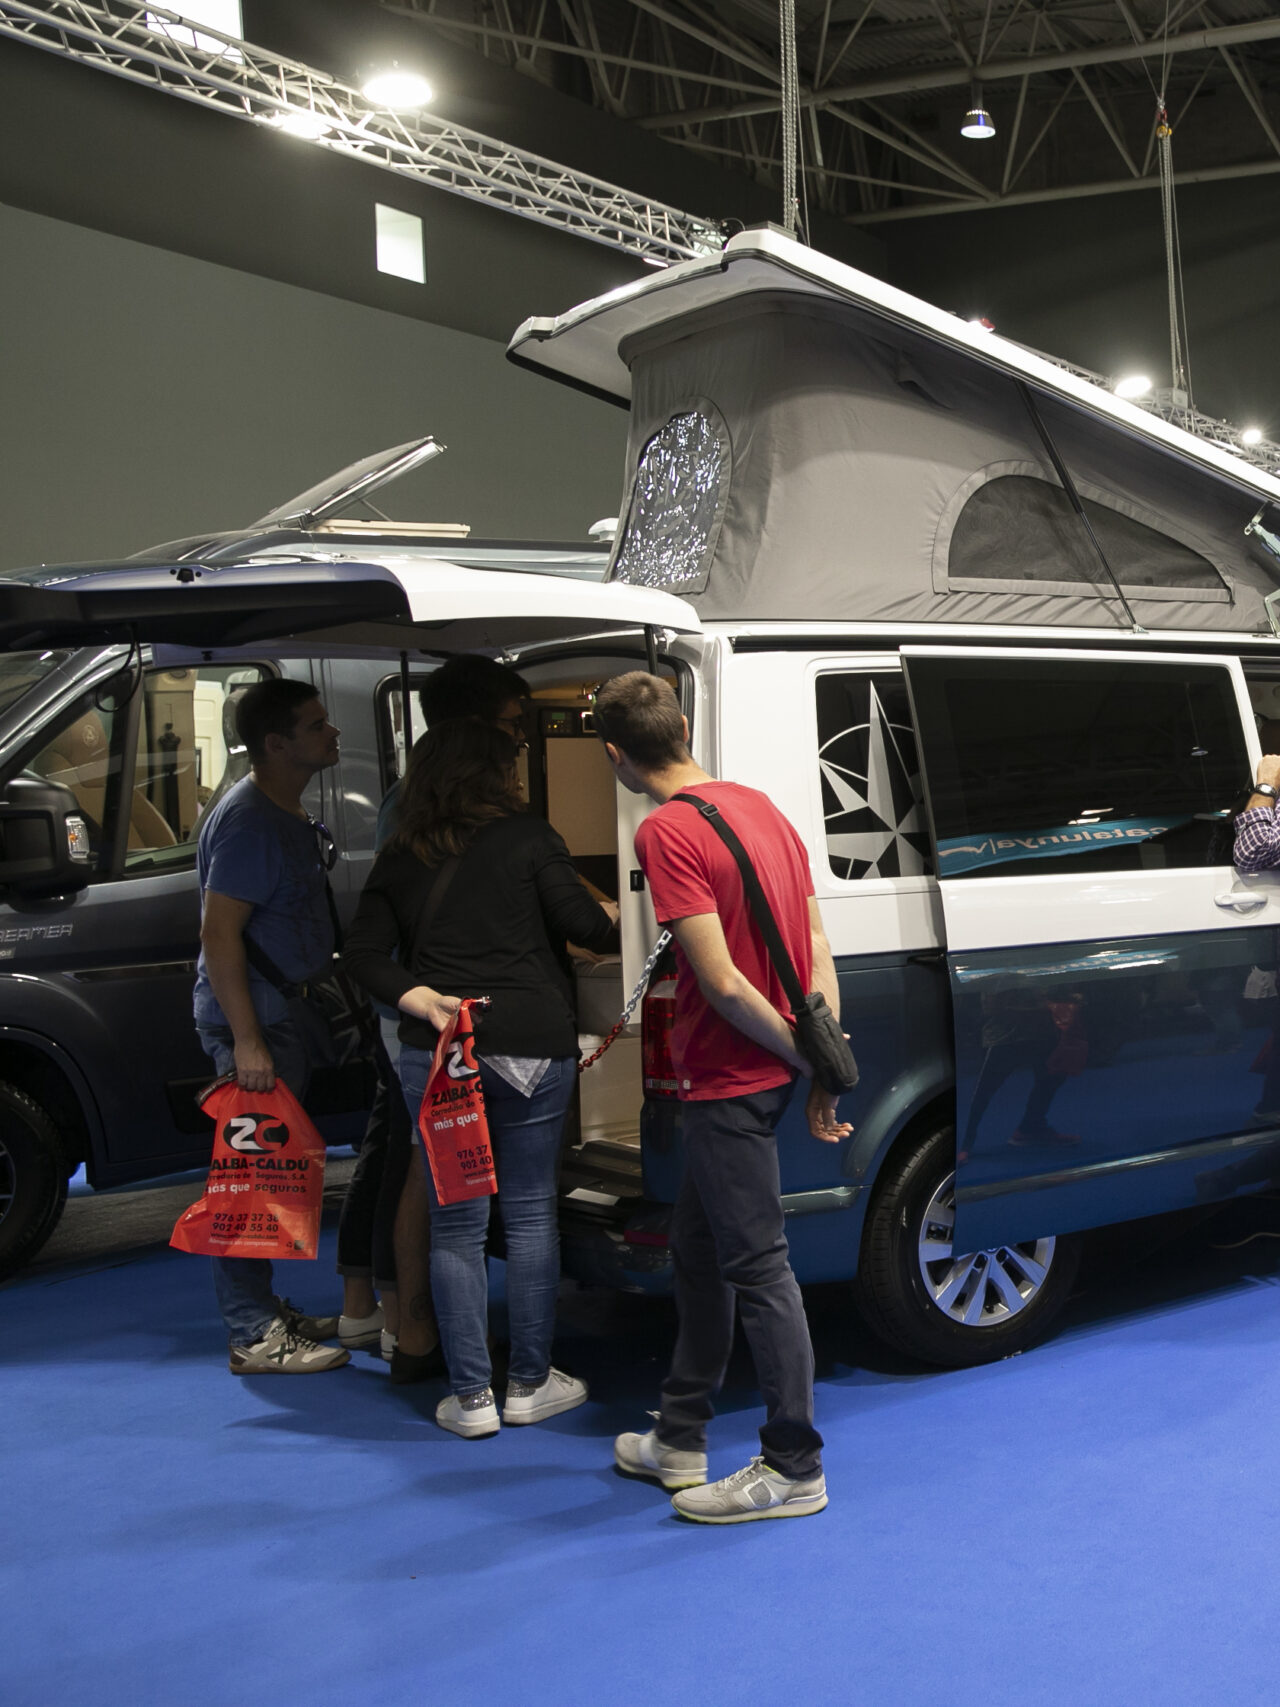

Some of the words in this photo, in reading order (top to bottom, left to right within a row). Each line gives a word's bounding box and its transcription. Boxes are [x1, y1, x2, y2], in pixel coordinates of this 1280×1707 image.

[433, 1117, 455, 1131] más
[457, 1112, 479, 1127] que
[456, 1149, 474, 1160] 976
[475, 1145, 488, 1155] 37
[211, 1156, 309, 1171] ALBA-CALDÚ
[460, 1159, 477, 1170] 902
[479, 1155, 492, 1165] 40
[229, 1183, 251, 1194] que
[254, 1183, 307, 1194] seguros
[214, 1212, 234, 1222] 976
[236, 1213, 248, 1222] 37
[250, 1213, 263, 1222] 37
[212, 1222, 232, 1232] 902
[234, 1222, 247, 1231] 40
[249, 1223, 262, 1232] 55
[265, 1223, 278, 1232] 40
